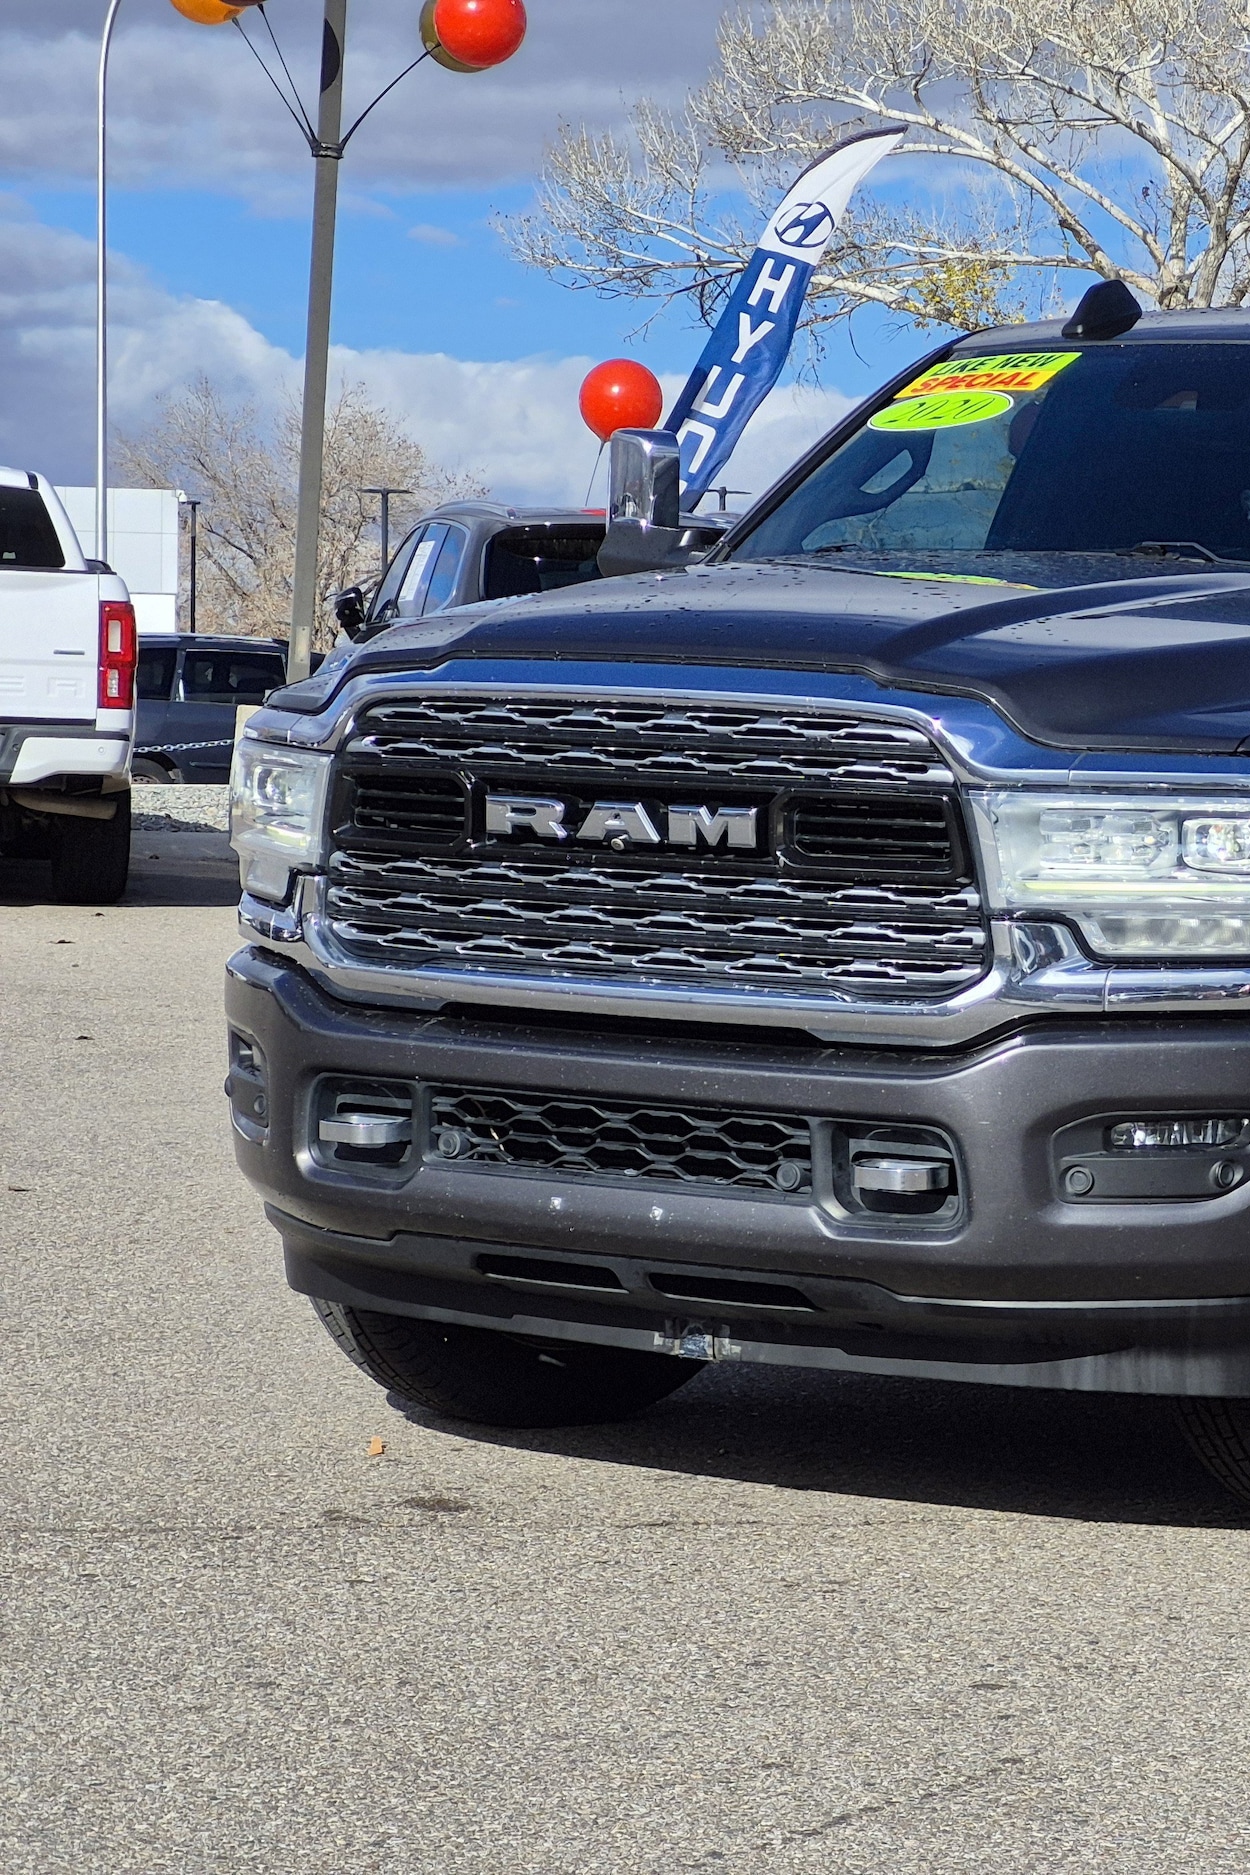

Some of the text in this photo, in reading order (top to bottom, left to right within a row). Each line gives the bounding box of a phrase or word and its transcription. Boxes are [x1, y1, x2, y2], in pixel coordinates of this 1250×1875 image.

[678, 257, 796, 496] HYUN
[930, 354, 1065, 376] LIKE NEW
[911, 371, 1039, 393] SPECIAL
[885, 397, 996, 425] 2020
[485, 794, 758, 848] RAM
